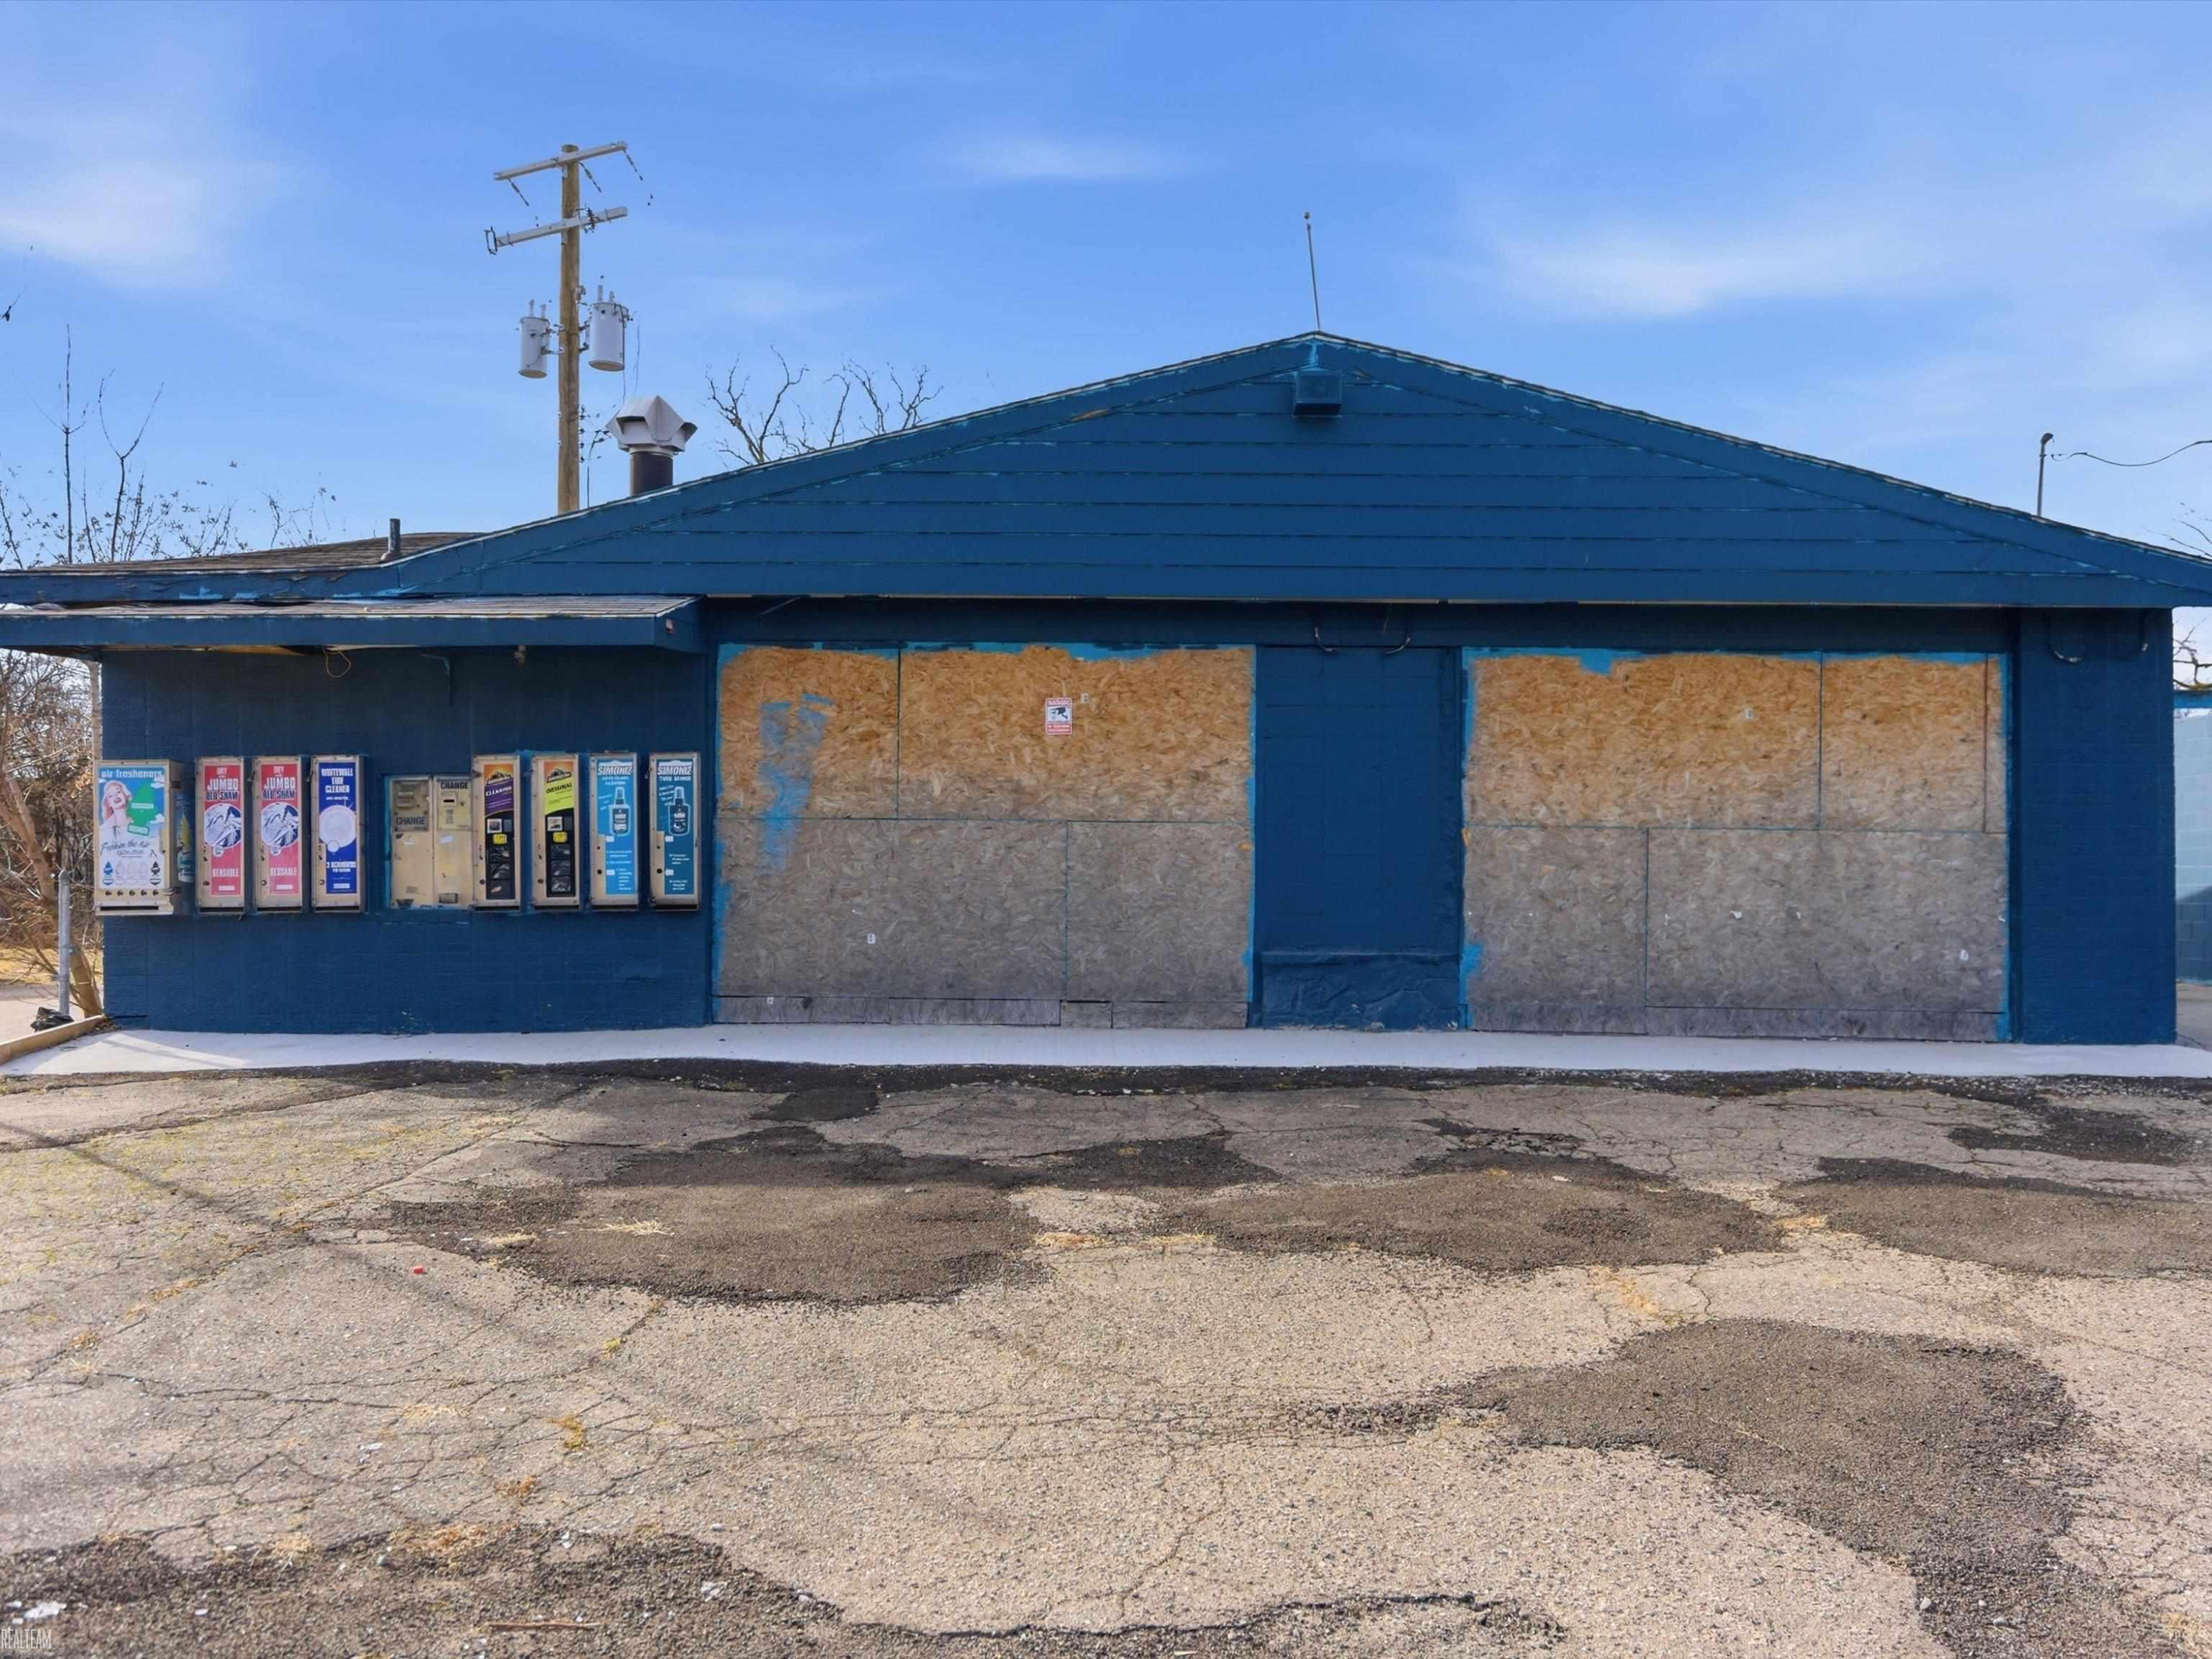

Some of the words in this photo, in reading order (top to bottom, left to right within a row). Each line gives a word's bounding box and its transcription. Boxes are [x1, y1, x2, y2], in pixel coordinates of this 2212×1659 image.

[597, 765, 633, 776] SIMONIZ
[658, 765, 692, 776] SIMONIZ
[207, 778, 239, 790] JUMBO
[264, 776, 296, 790] JUMBO
[441, 782, 469, 790] CHANGE
[396, 816, 426, 825] CHANGE
